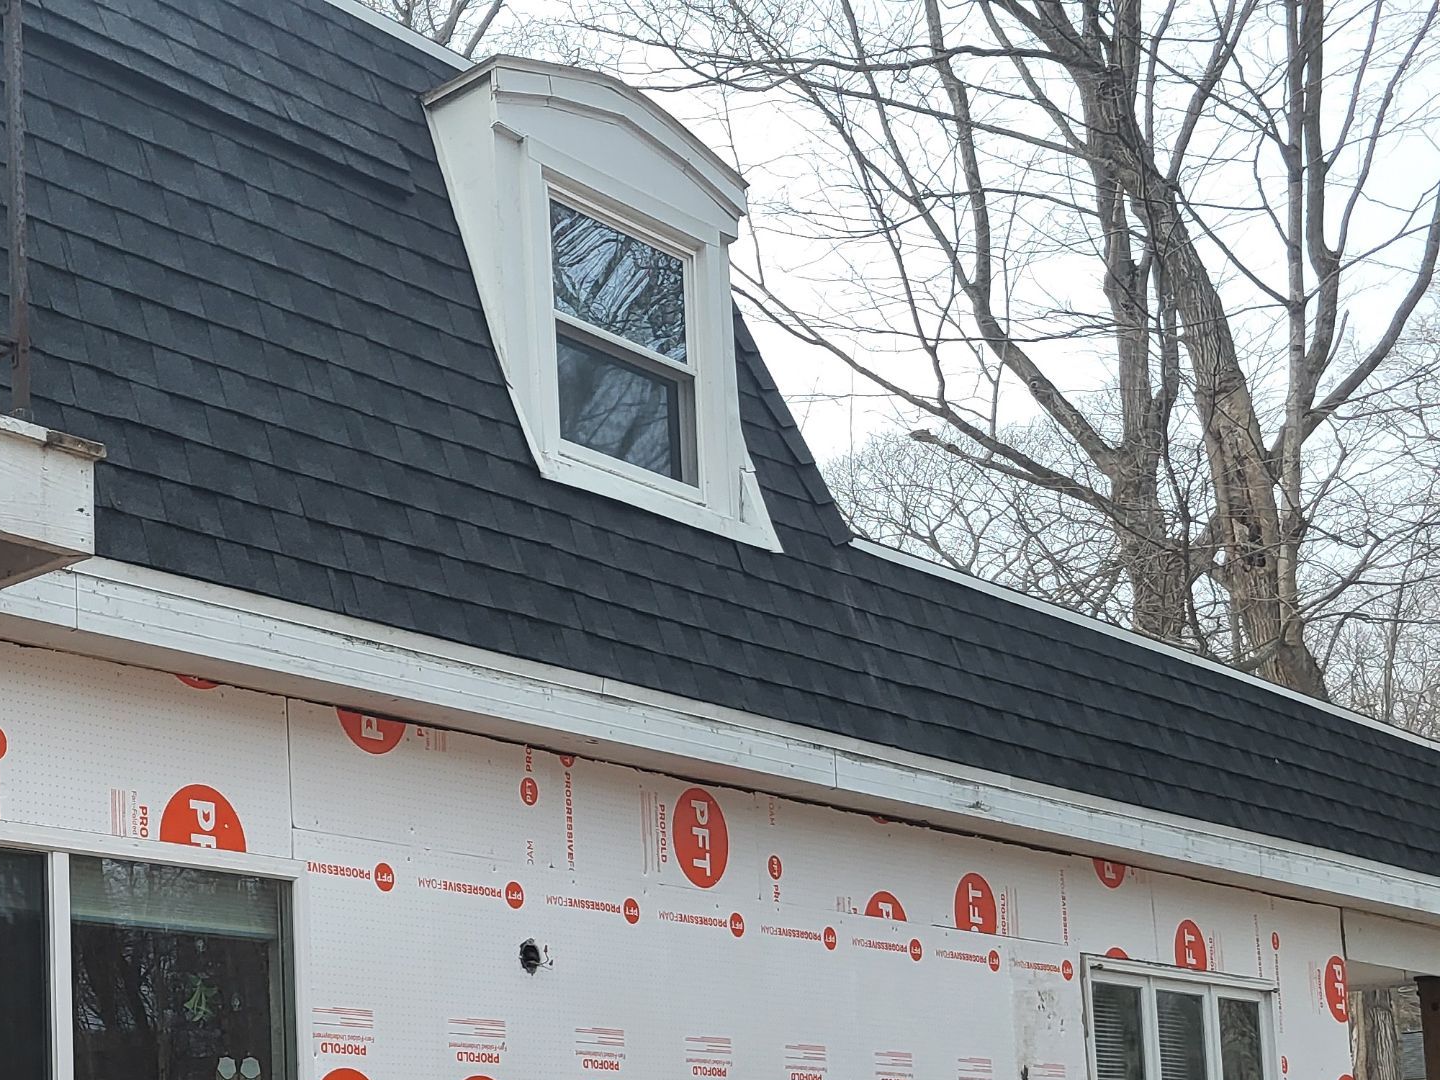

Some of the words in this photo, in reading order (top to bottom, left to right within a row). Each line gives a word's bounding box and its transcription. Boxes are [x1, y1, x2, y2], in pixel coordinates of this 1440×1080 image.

[659, 803, 668, 863] PROFOLD
[691, 799, 711, 877] PFT
[376, 873, 394, 884] PFT
[417, 877, 502, 897] PROGRESSIVEFOAM
[507, 889, 524, 900] PFT
[546, 896, 621, 913] PROGRESSIVEFOAM
[658, 911, 728, 927] PROGRESSIVEFOAM
[1184, 928, 1197, 969] FT
[1332, 964, 1347, 1016] PFT
[320, 1042, 367, 1056] PROFOLD
[456, 1052, 500, 1064] PROFOLD
[582, 1058, 620, 1070] PROFOLD
[692, 1066, 727, 1078] PROFOLD
